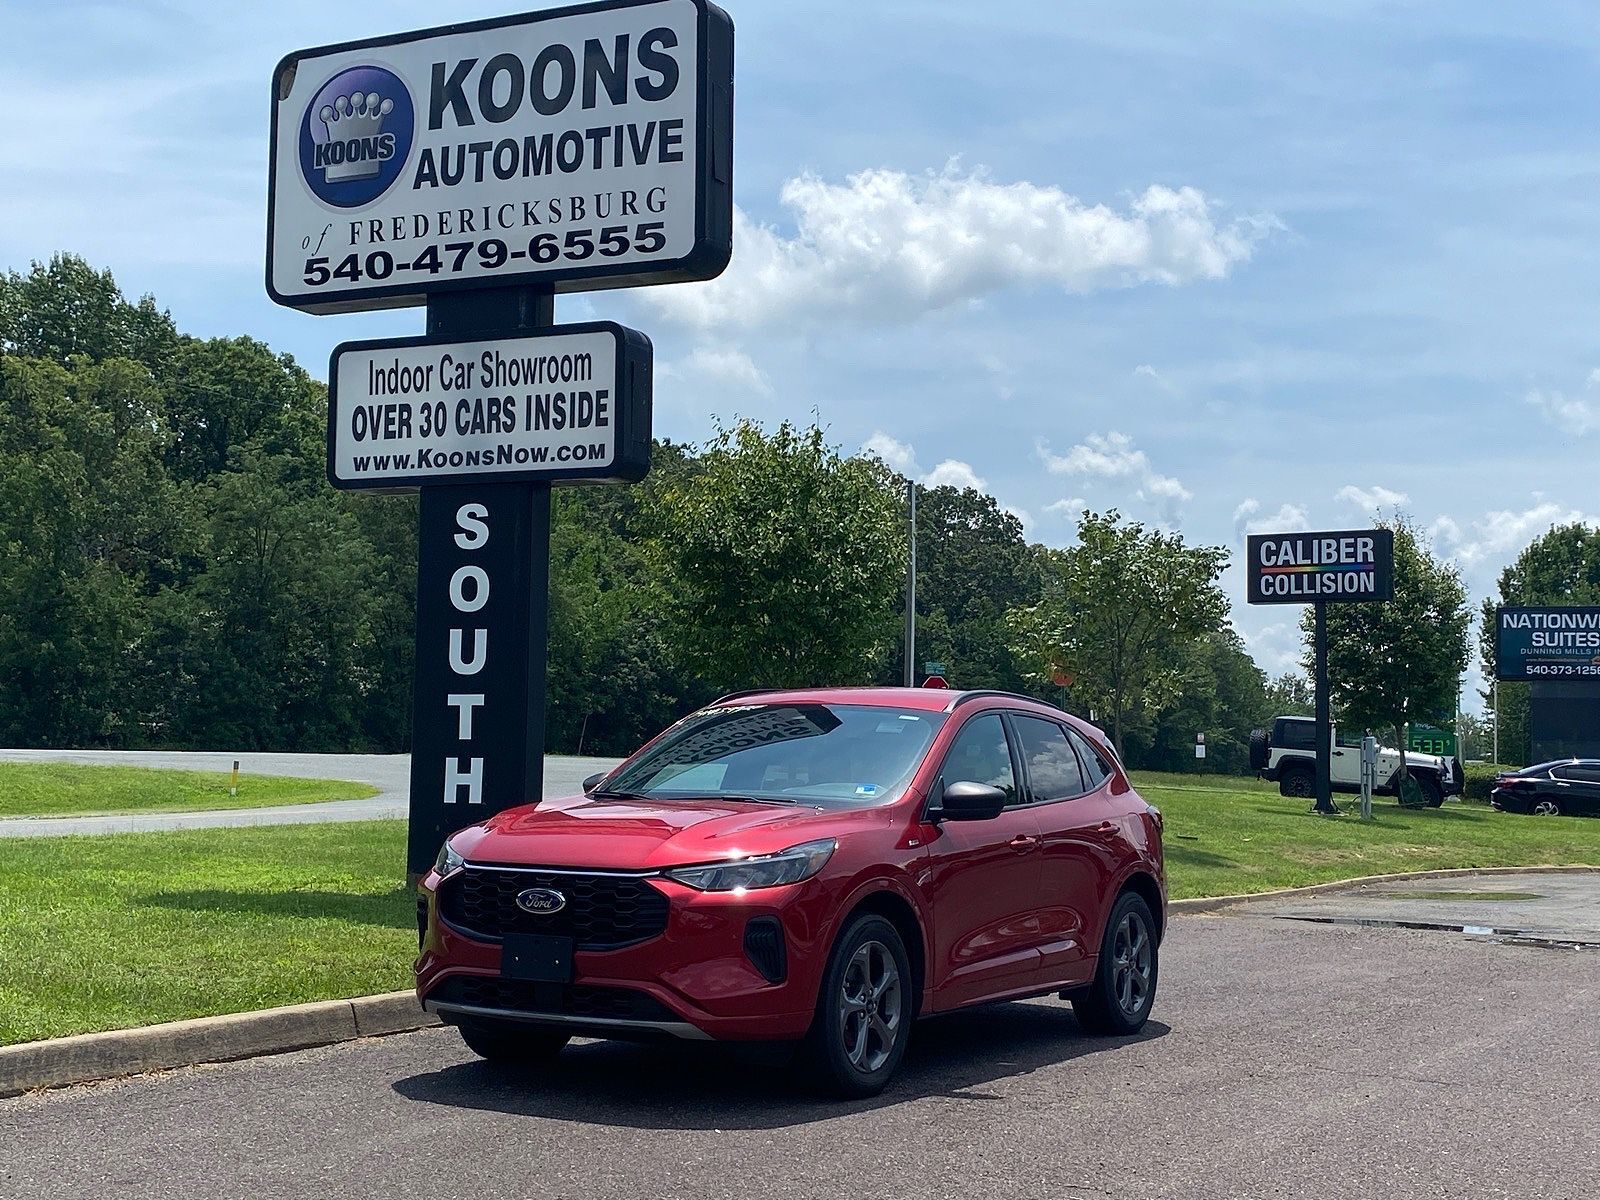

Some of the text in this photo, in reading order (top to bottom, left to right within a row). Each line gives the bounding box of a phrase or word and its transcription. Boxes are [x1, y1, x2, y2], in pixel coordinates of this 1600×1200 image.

[428, 27, 680, 131] KOONS
[315, 134, 395, 168] KOONS
[412, 119, 684, 189] AUTOMOTIVE
[302, 187, 667, 257] of FREDERICKSBURG
[302, 222, 667, 286] 540-479-6555
[368, 350, 592, 396] Indoor Car Showroom
[351, 390, 609, 442] OVER 30 CARS INSIDE
[1260, 537, 1374, 566] CALIBER
[1260, 572, 1374, 596] COLLISION
[444, 503, 490, 804] SOUTH
[1531, 631, 1600, 647] SUITES
[525, 893, 553, 909] Ford
